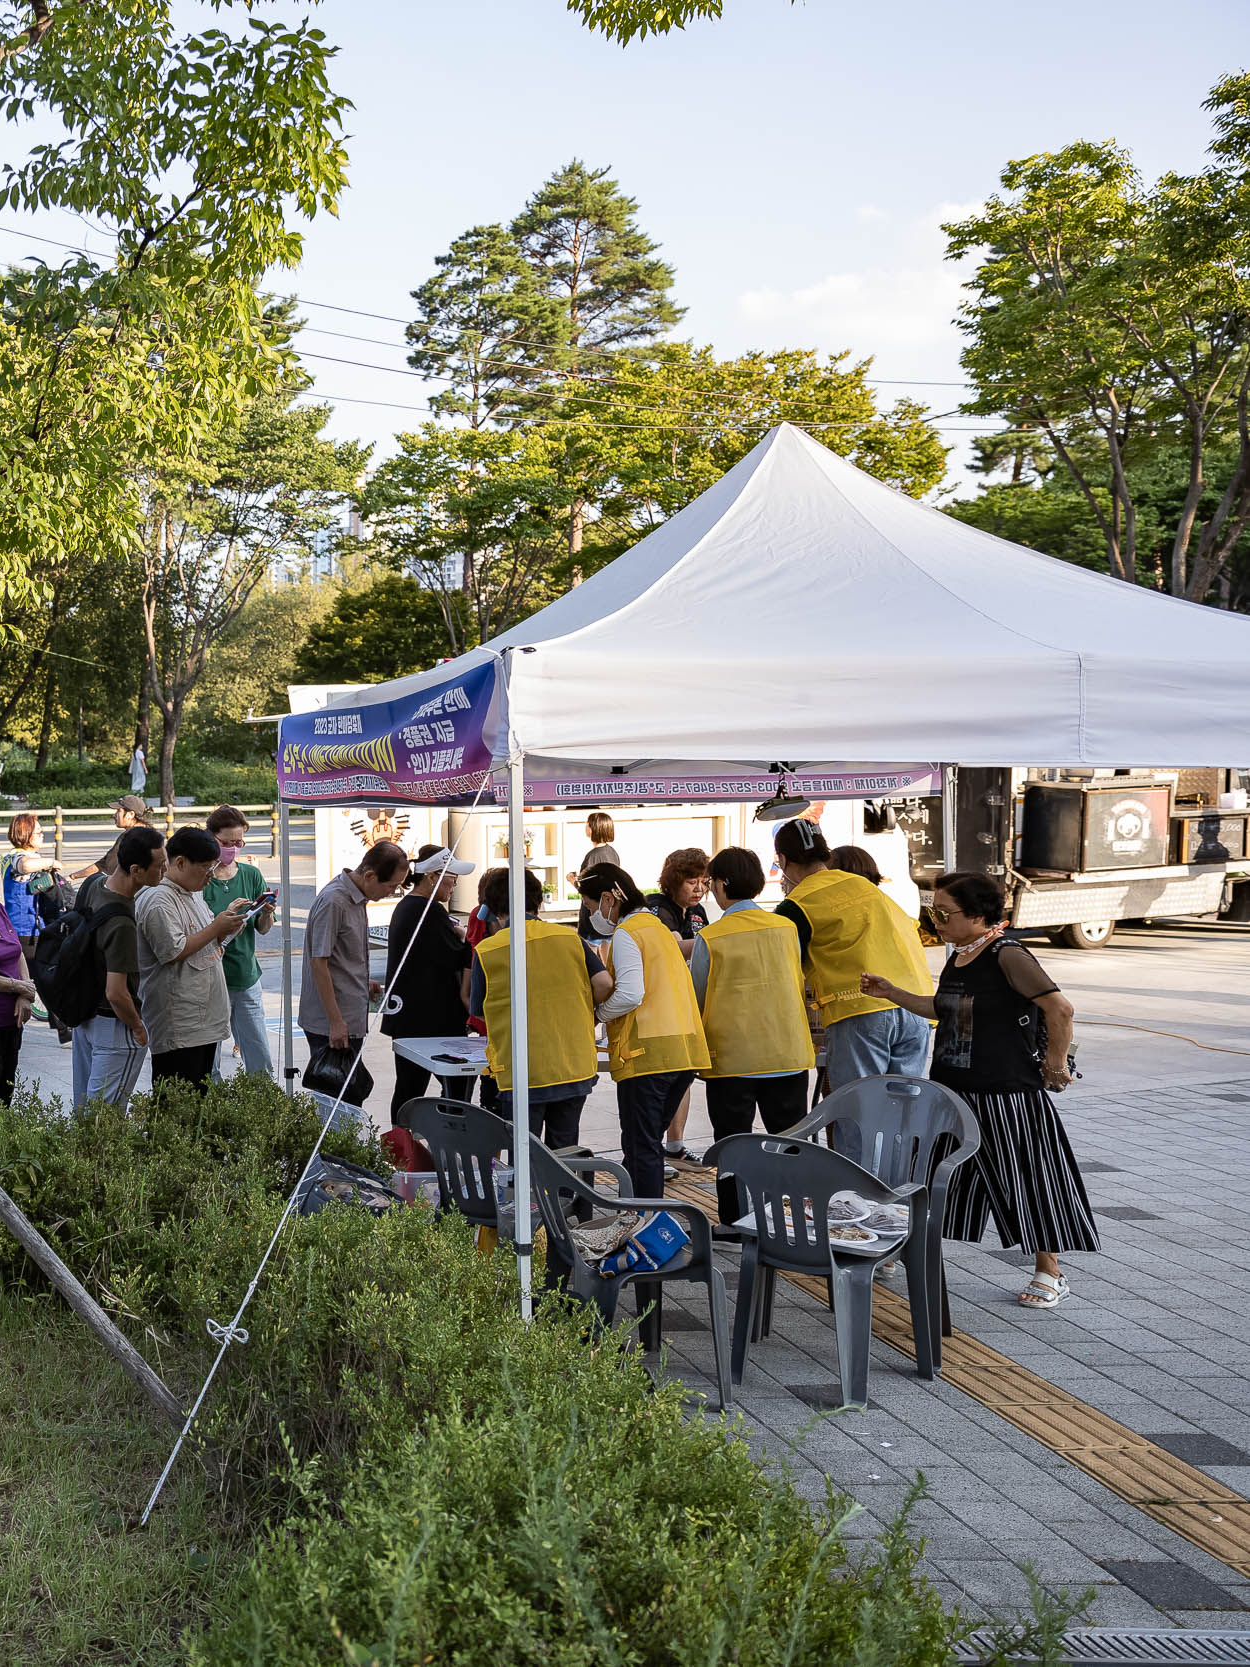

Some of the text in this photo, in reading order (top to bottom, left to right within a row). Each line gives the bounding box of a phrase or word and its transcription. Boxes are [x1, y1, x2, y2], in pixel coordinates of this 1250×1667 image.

[314, 717, 327, 735] 2023
[431, 720, 455, 743] 지급
[410, 751, 430, 775] 안내
